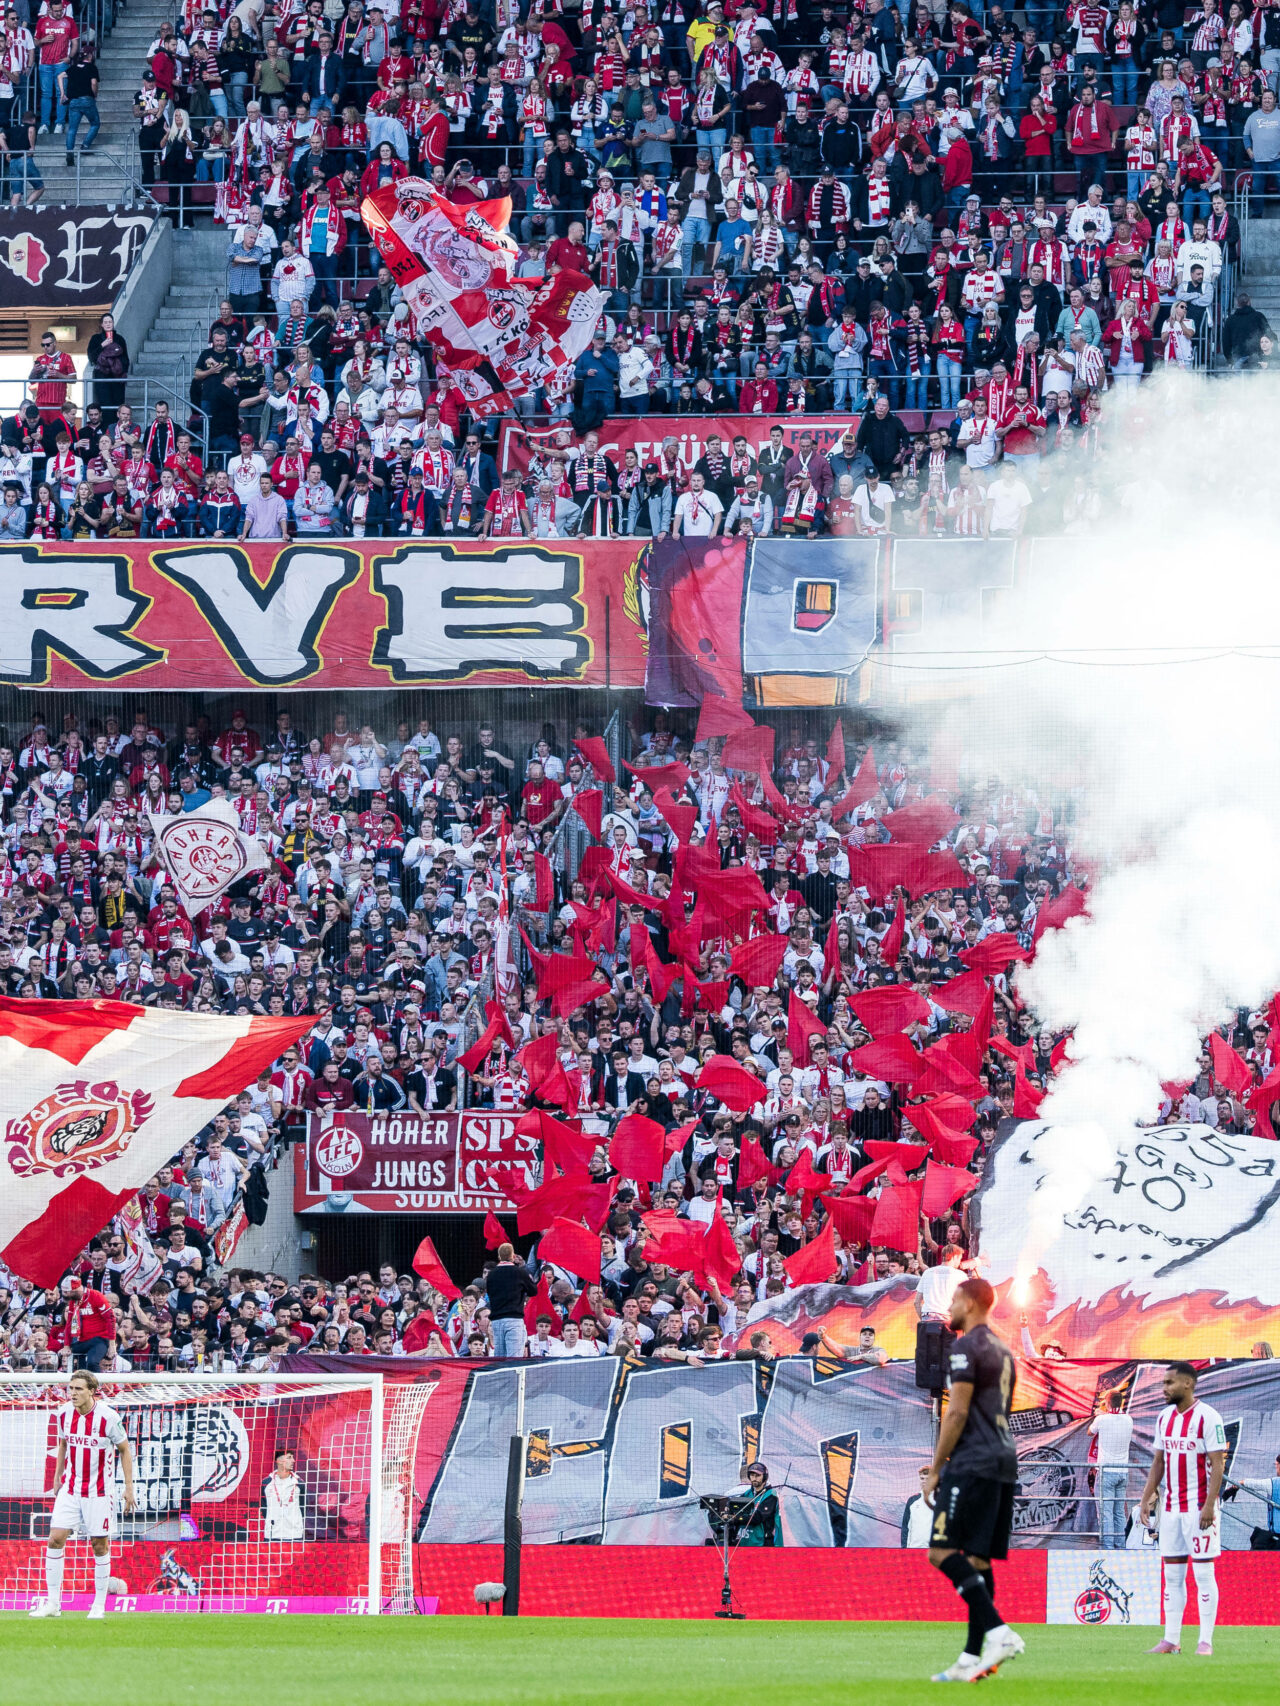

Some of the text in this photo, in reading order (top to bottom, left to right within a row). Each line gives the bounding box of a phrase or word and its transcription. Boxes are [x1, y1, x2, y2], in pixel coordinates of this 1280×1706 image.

[171, 829, 230, 859] HÖHER
[178, 852, 234, 889] JUNGS
[371, 1113, 449, 1144] HÖHER
[323, 1143, 354, 1161] 1.FC
[326, 1160, 354, 1174] KÖLN
[371, 1161, 446, 1187] JUNGS
[65, 1435, 90, 1446] REWE
[102, 1518, 109, 1529] 4
[933, 1511, 947, 1534] 4
[1193, 1536, 1210, 1554] 37
[1080, 1603, 1104, 1615] 1.FC
[1084, 1613, 1100, 1621] KÖLN
